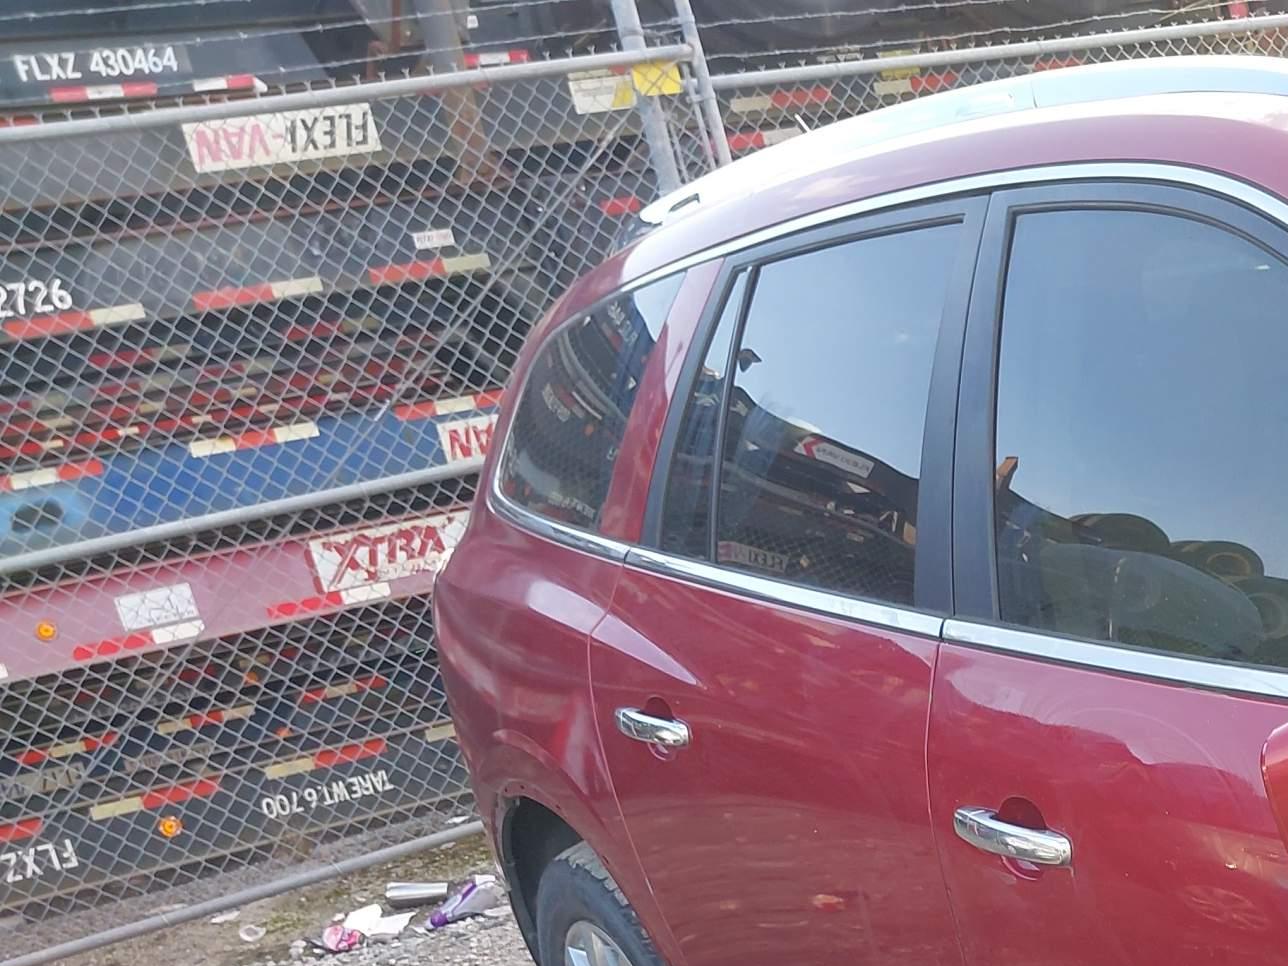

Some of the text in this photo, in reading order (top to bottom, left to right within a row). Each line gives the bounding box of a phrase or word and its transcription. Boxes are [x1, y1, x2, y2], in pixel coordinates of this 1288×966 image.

[13, 47, 178, 82] FLXZ 430464
[194, 111, 370, 167] FLEXI-VAN
[321, 524, 446, 588] XTRA
[0, 838, 80, 884] FLXZ
